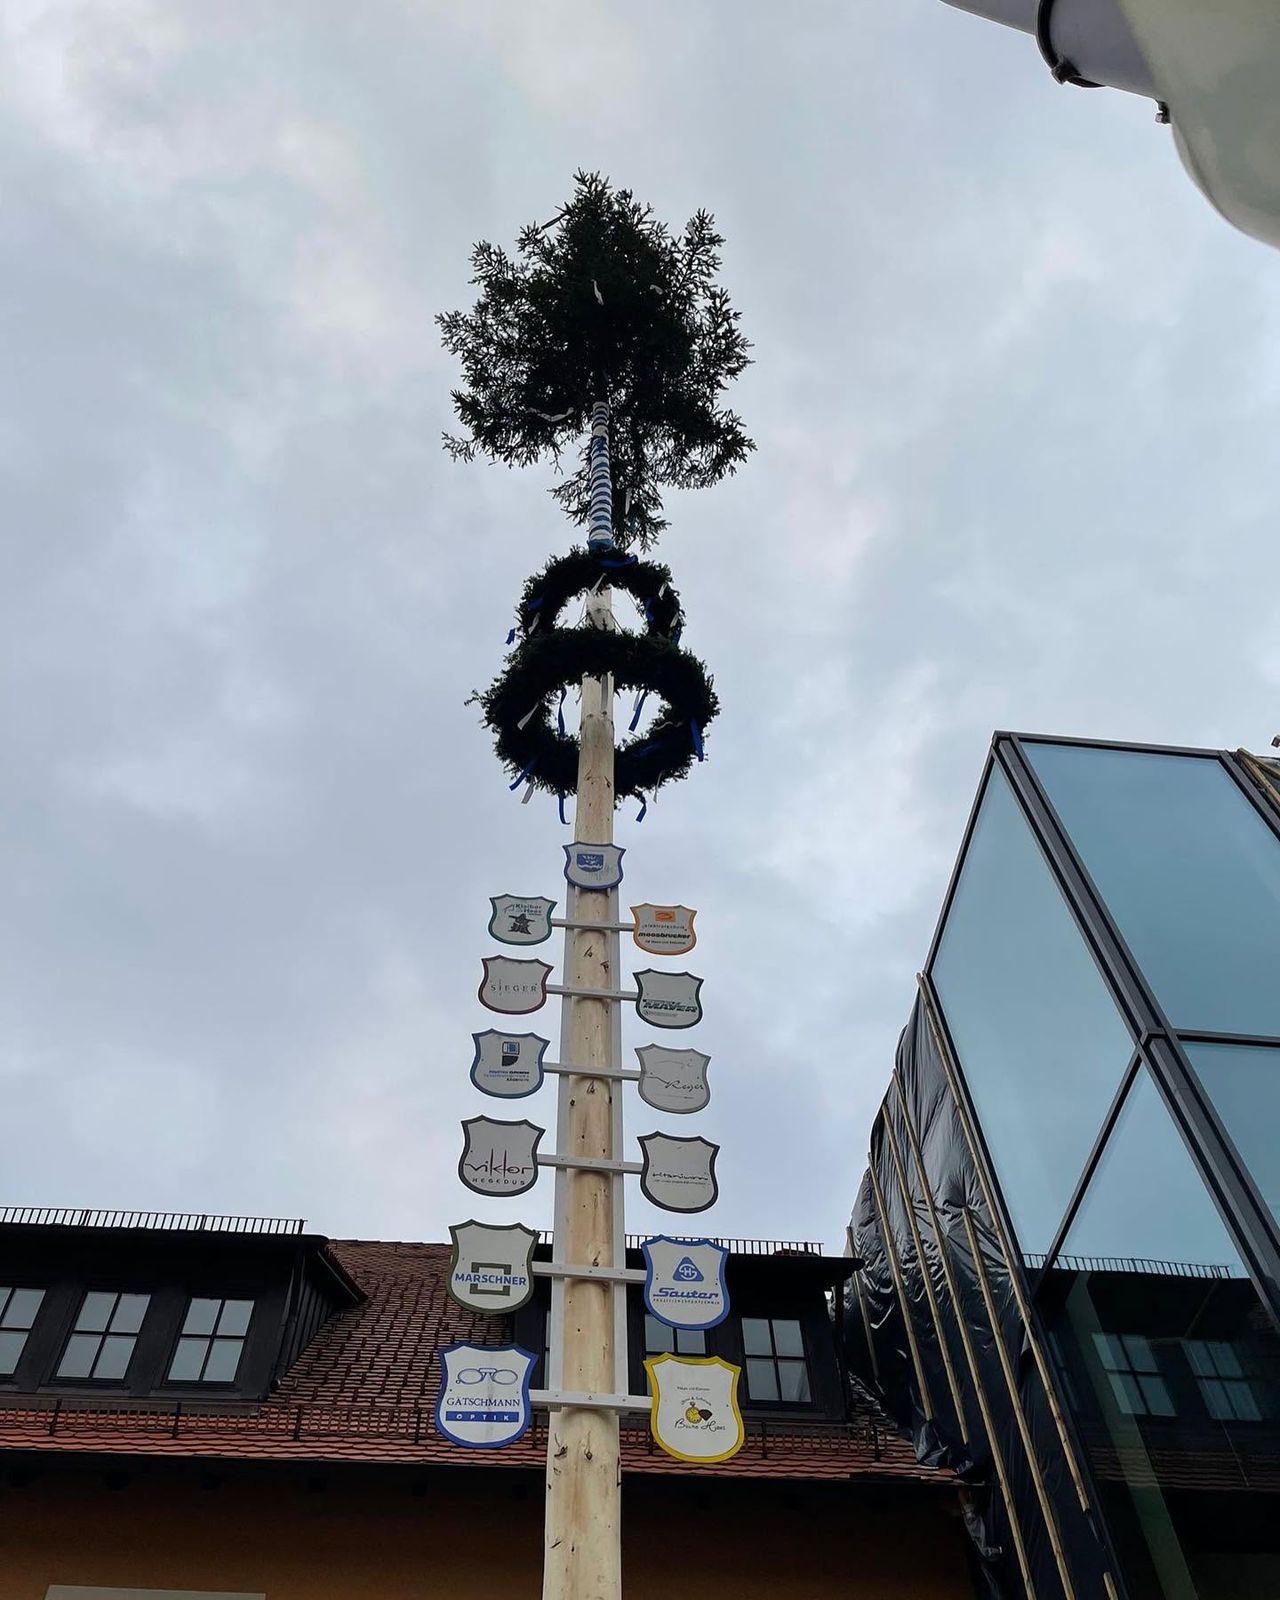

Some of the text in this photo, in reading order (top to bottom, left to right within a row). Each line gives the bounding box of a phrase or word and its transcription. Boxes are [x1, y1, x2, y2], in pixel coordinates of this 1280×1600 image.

[455, 1273, 527, 1286] MARSCHNER
[653, 1288, 719, 1299] Sauter
[456, 1413, 509, 1421] OPTIK
